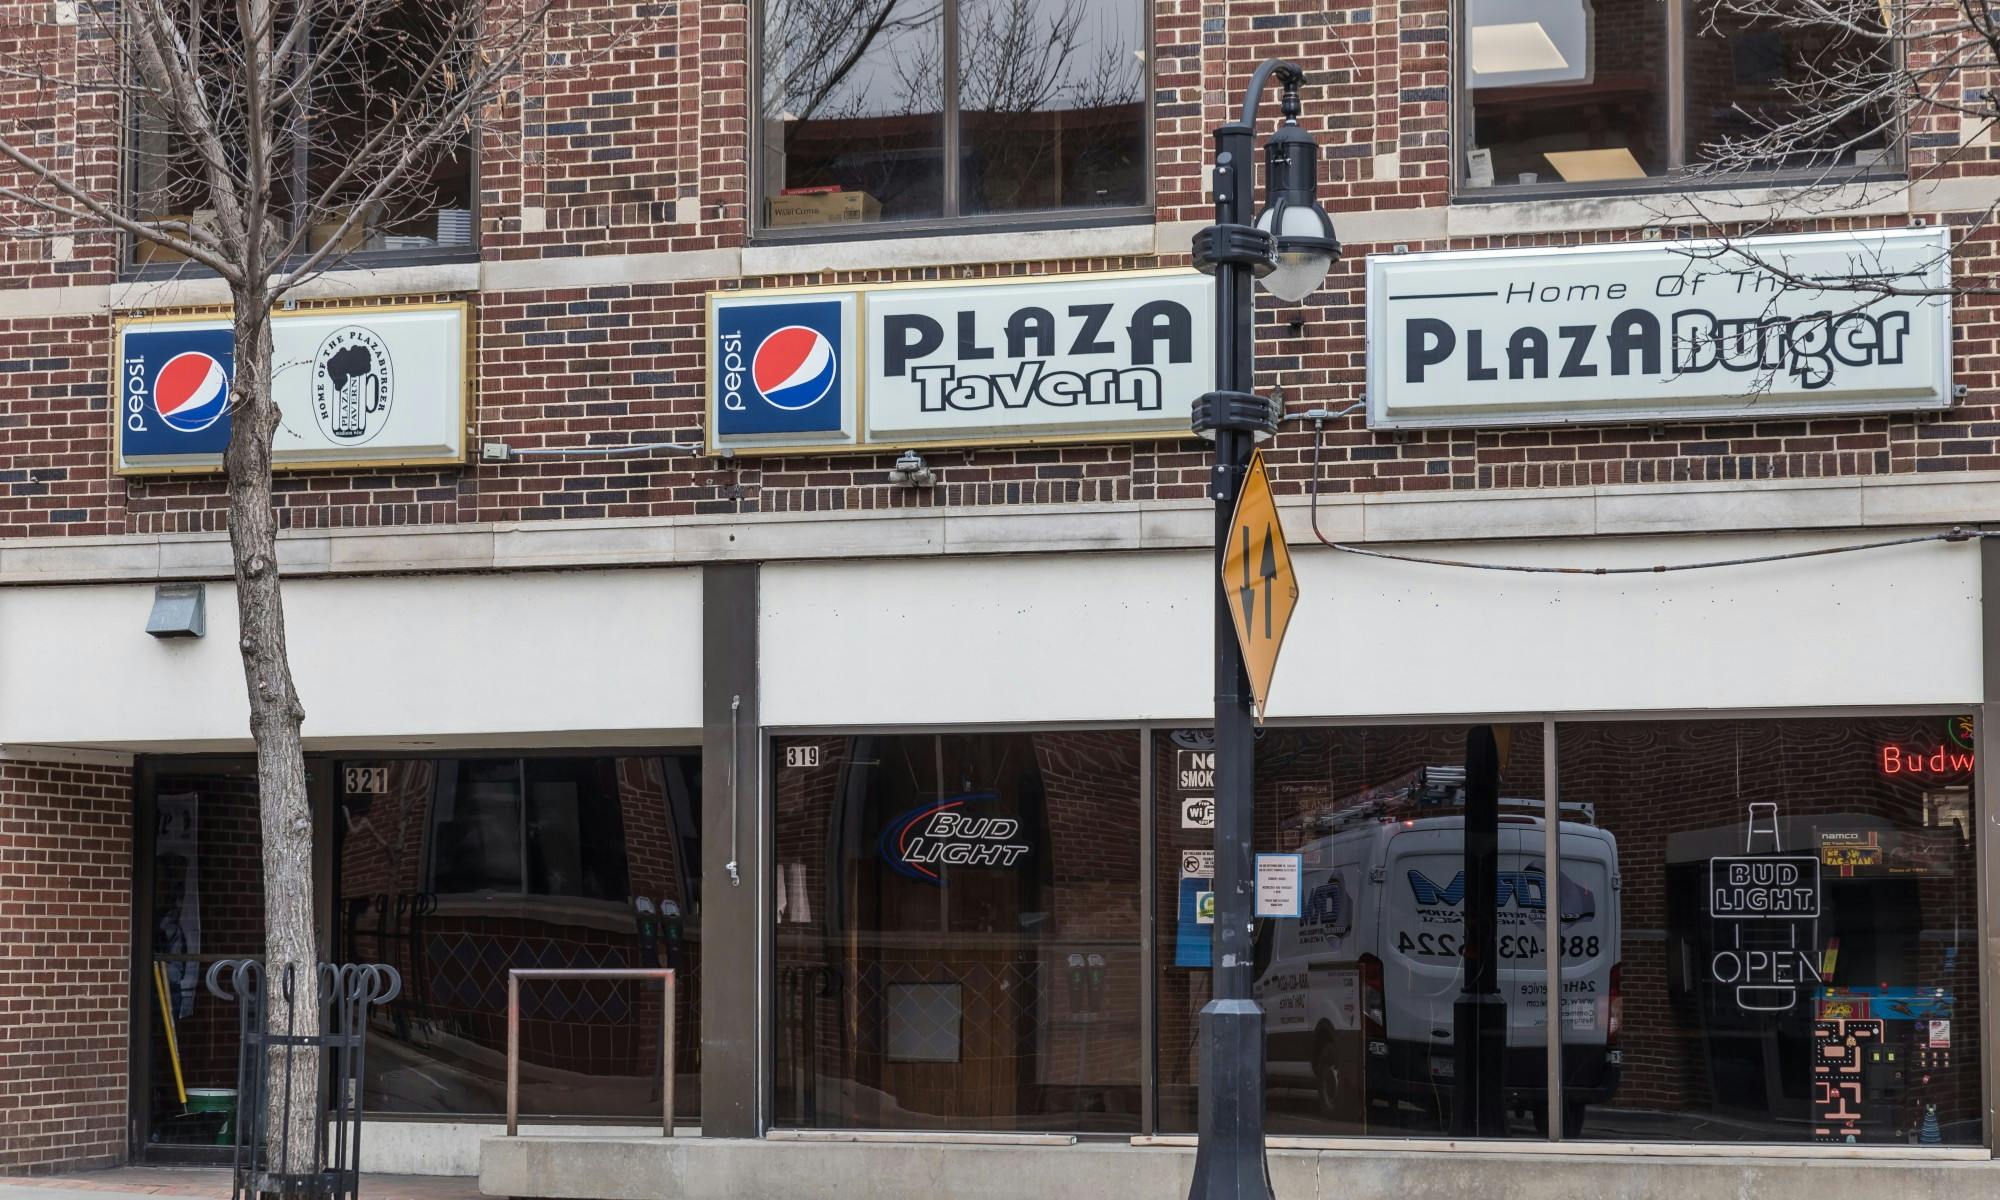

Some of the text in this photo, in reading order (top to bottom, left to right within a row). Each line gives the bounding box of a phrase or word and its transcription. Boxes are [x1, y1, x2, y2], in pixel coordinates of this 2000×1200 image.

[1506, 281, 1627, 304] Home
[1655, 272, 1706, 298] Of
[323, 335, 344, 357] THE
[883, 300, 1193, 377] PLAZA
[318, 362, 326, 378] OF
[721, 330, 746, 411] pepsi
[126, 354, 148, 433] pepsi
[911, 361, 1163, 412] Tavern
[318, 384, 329, 420] HOME
[788, 746, 818, 766] 319
[1884, 745, 1975, 773] Budw
[347, 768, 386, 793] 321
[1180, 770, 1215, 788] SMOK
[924, 812, 1019, 840] BUD
[1189, 807, 1215, 817] WiF
[902, 838, 1029, 866] LIGHT
[1729, 864, 1799, 886] BUD
[1712, 951, 1823, 983] OPEN
